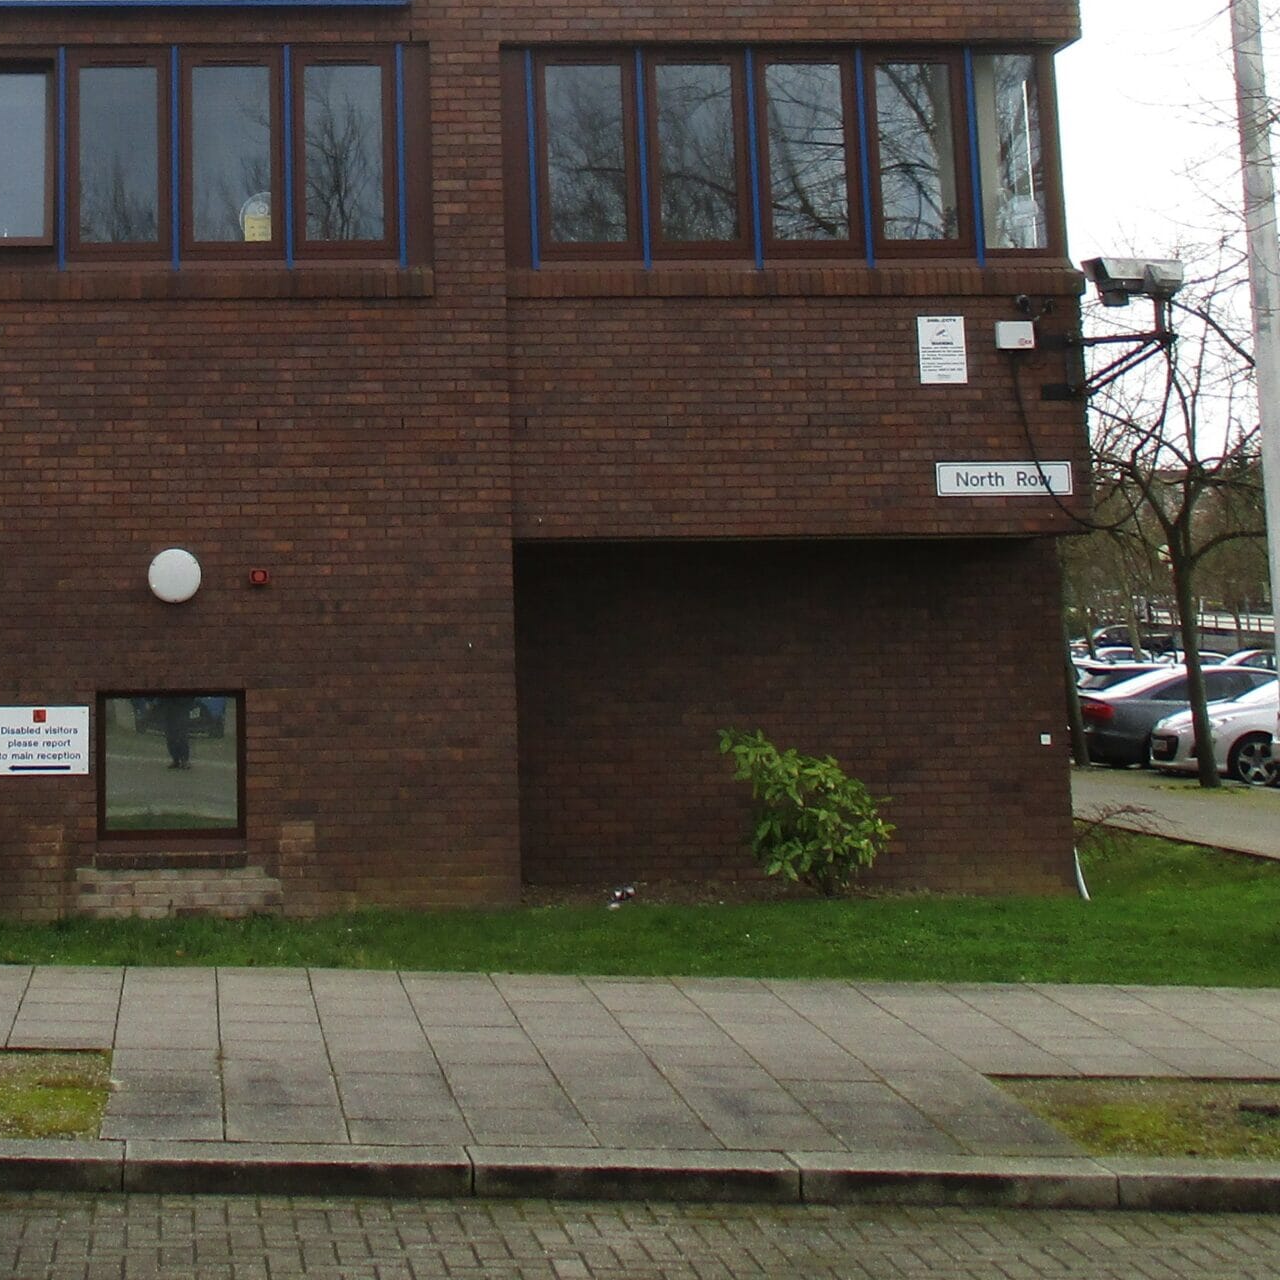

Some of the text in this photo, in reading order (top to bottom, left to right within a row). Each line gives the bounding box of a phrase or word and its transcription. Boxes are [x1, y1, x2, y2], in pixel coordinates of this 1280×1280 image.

[955, 471, 1052, 487] North Row
[0, 726, 79, 735] Disabled visitors
[7, 739, 71, 748] please report
[11, 751, 34, 760] main
[37, 751, 81, 761] reception
